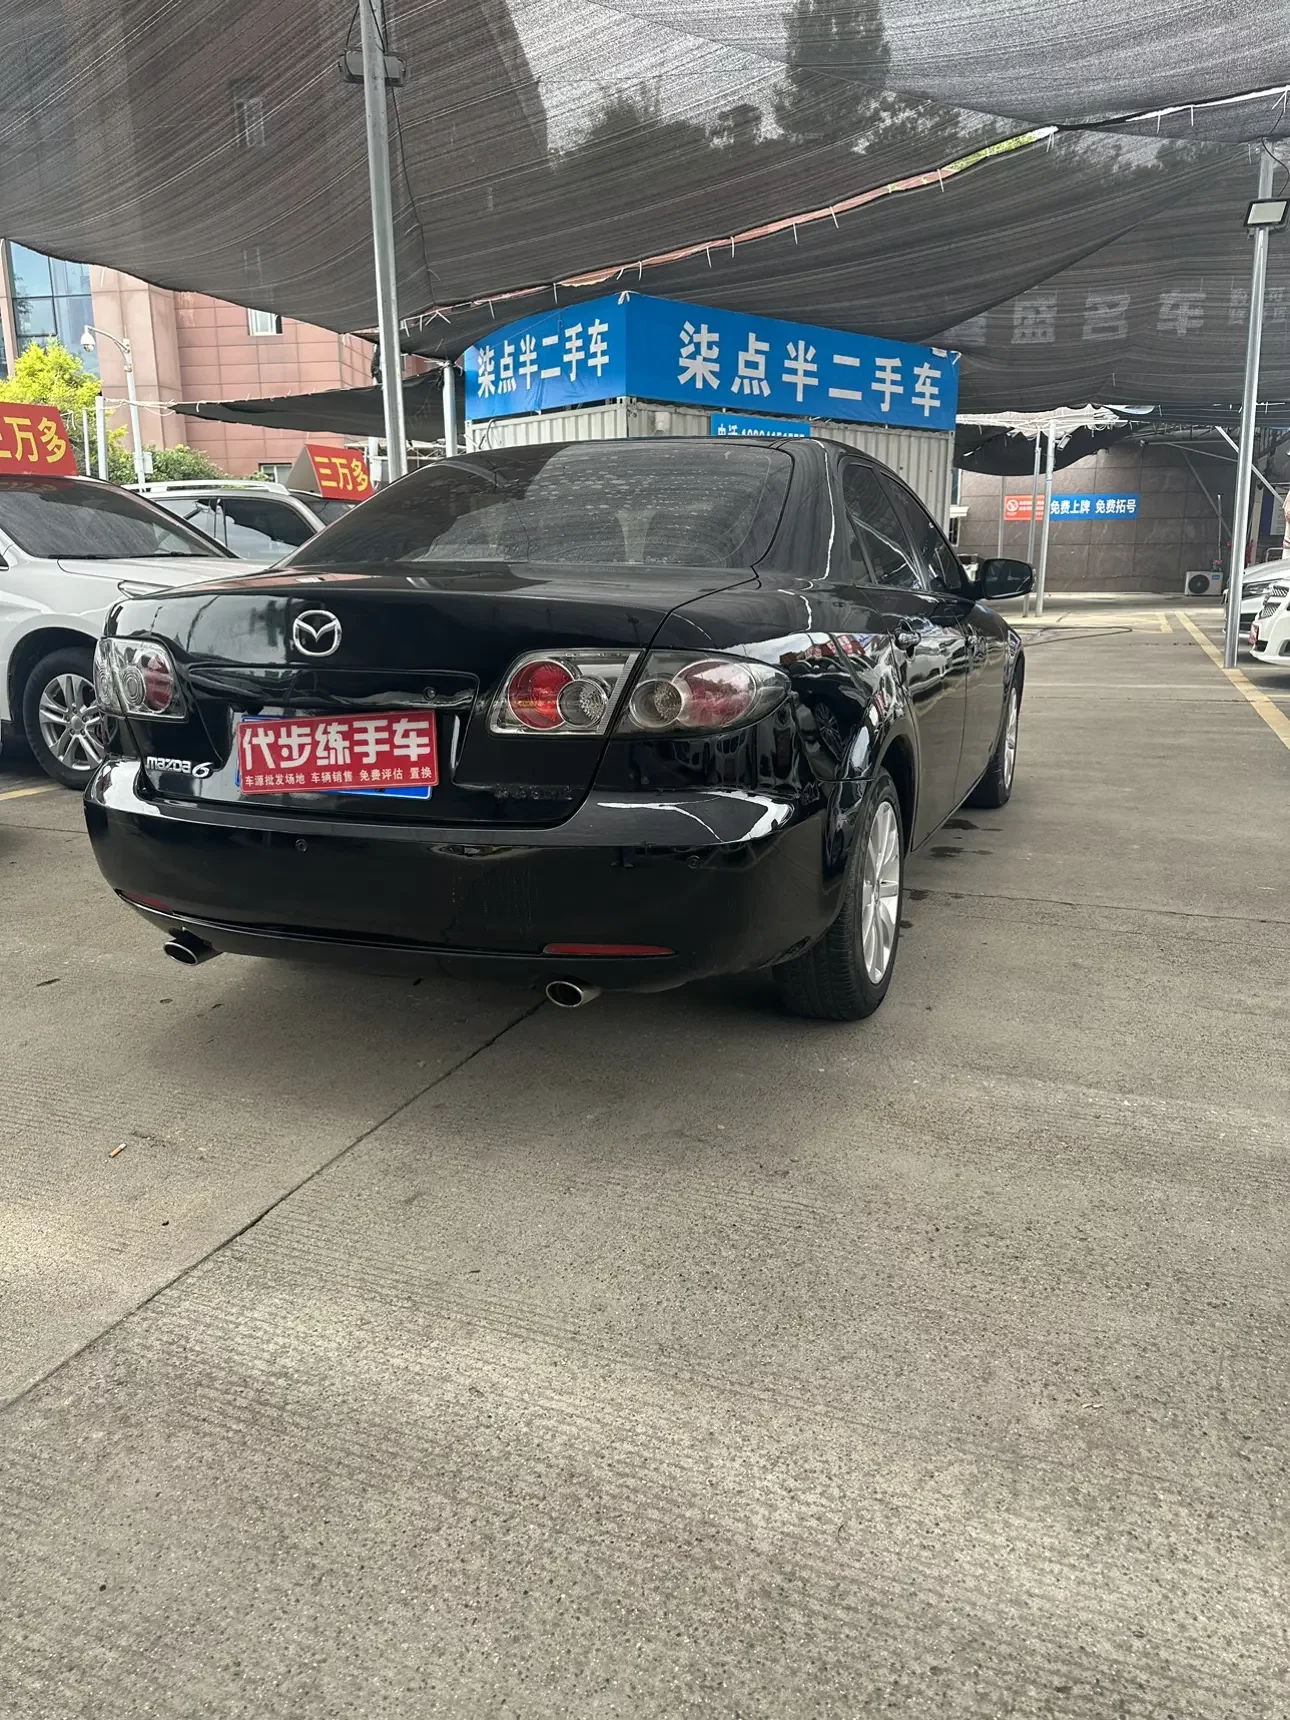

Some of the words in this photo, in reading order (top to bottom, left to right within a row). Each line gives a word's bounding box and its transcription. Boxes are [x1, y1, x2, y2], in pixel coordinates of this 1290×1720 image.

[477, 318, 610, 398] 柒点半二手车
[676, 320, 942, 417] 柒点半二手车
[313, 456, 369, 492] 三万多
[1050, 499, 1091, 515] 免费上牌
[1095, 498, 1137, 514] 免费拓号
[242, 718, 431, 770] 代步练手车
[245, 772, 306, 787] 车源批发场地
[310, 770, 353, 784] 车辆销售
[359, 768, 403, 782] 免费评估
[409, 766, 432, 780] 置换
